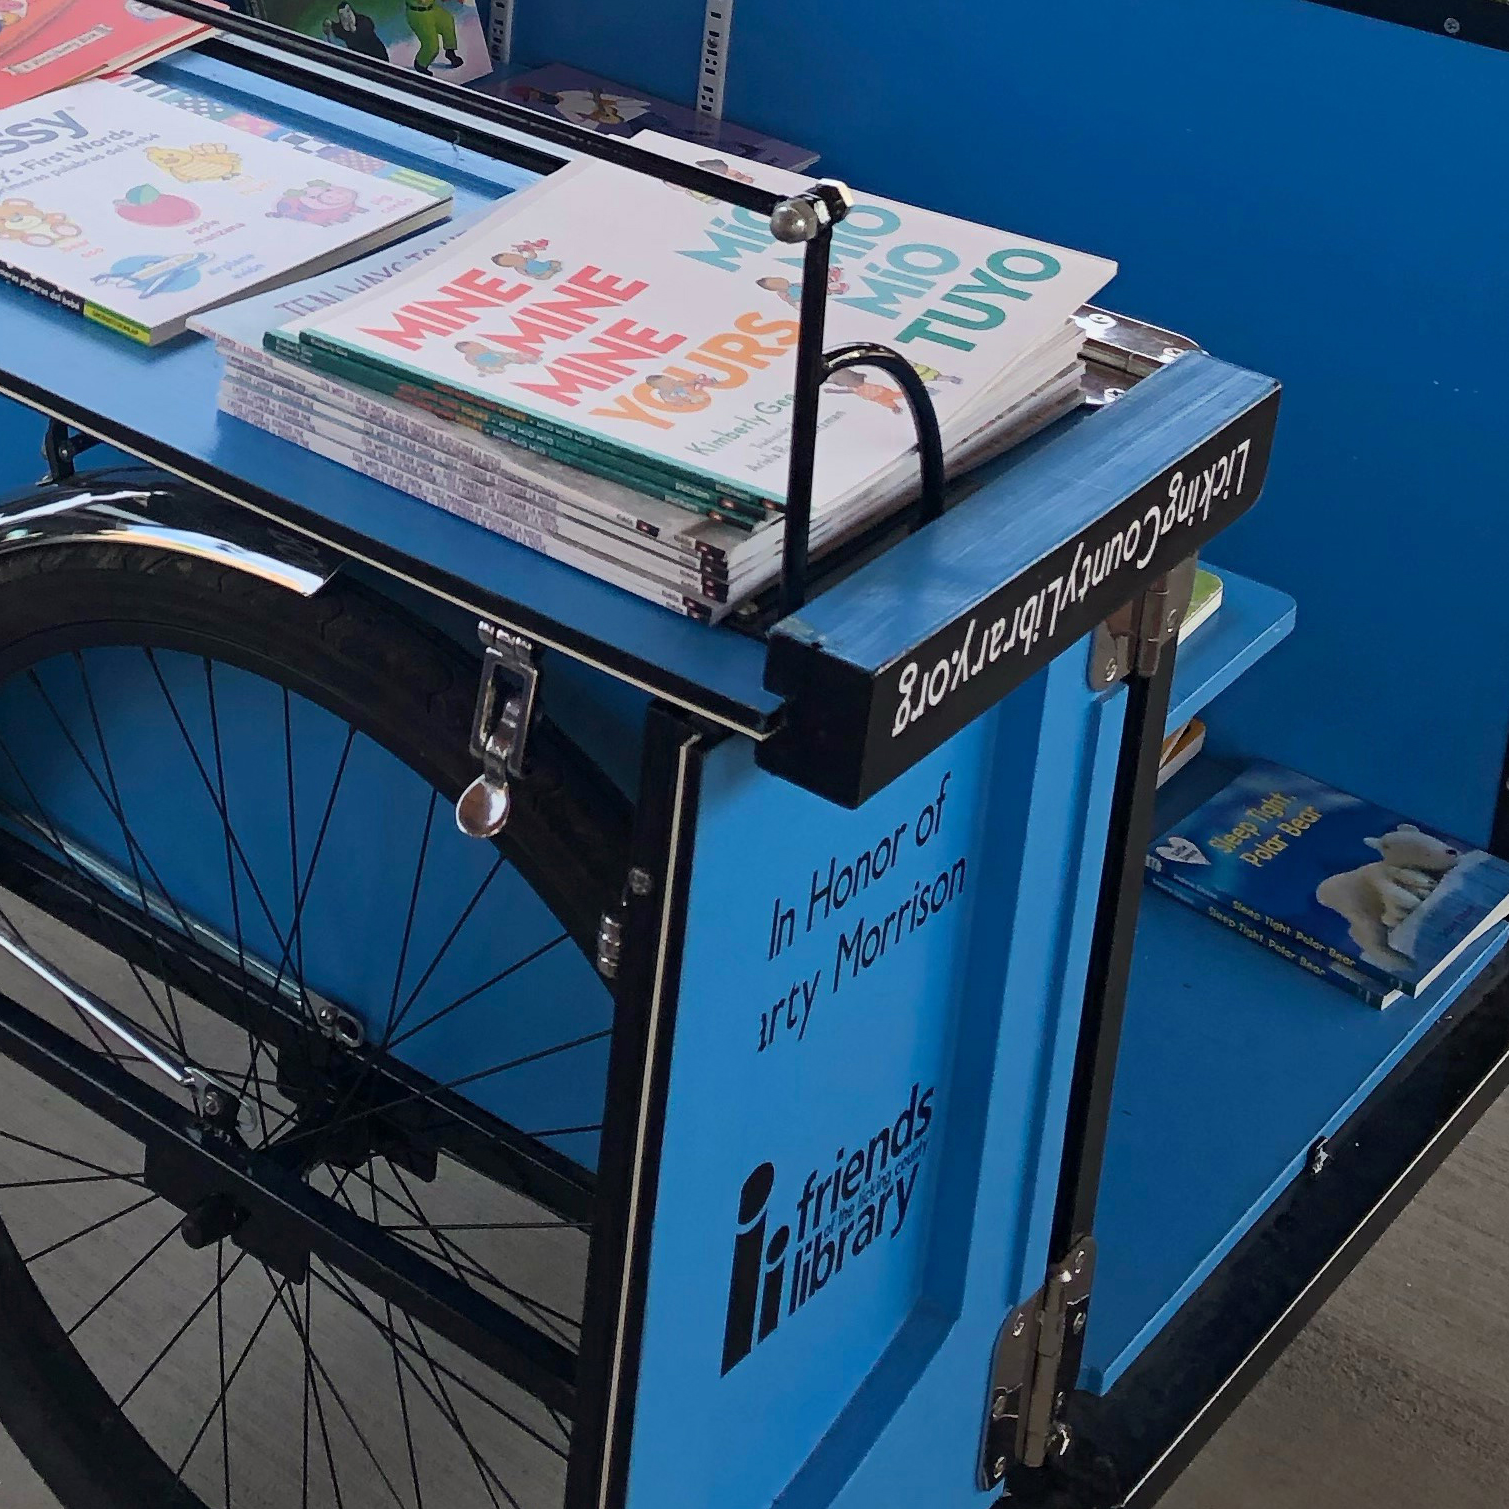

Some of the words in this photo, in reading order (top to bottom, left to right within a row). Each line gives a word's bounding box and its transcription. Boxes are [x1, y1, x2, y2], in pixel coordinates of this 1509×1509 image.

[20, 147, 71, 173] First
[66, 126, 134, 154] Words
[355, 267, 534, 352] MINE
[473, 265, 651, 358] MINE
[894, 247, 1062, 352] TUYO
[508, 317, 689, 408] MINE
[588, 311, 801, 430] YOURS
[684, 412, 771, 457] Kimberly
[891, 438, 1251, 738] LickingCountyLibrary.org
[767, 897, 796, 962] In
[806, 822, 908, 933] Honor
[915, 770, 952, 847] of
[1208, 820, 1262, 854] Sleep
[1246, 791, 1298, 824] Tight,
[1239, 833, 1289, 869] Polar
[1276, 805, 1323, 837] Bear
[832, 857, 966, 994] Morrison
[1207, 905, 1237, 928] Sleep
[1267, 938, 1296, 960] Polar
[1299, 955, 1327, 977] Bear
[1232, 899, 1261, 922] Sleep
[1294, 930, 1326, 952] Polar
[1327, 947, 1357, 968] Bear
[796, 1082, 936, 1243] friends
[787, 1162, 920, 1318] library
